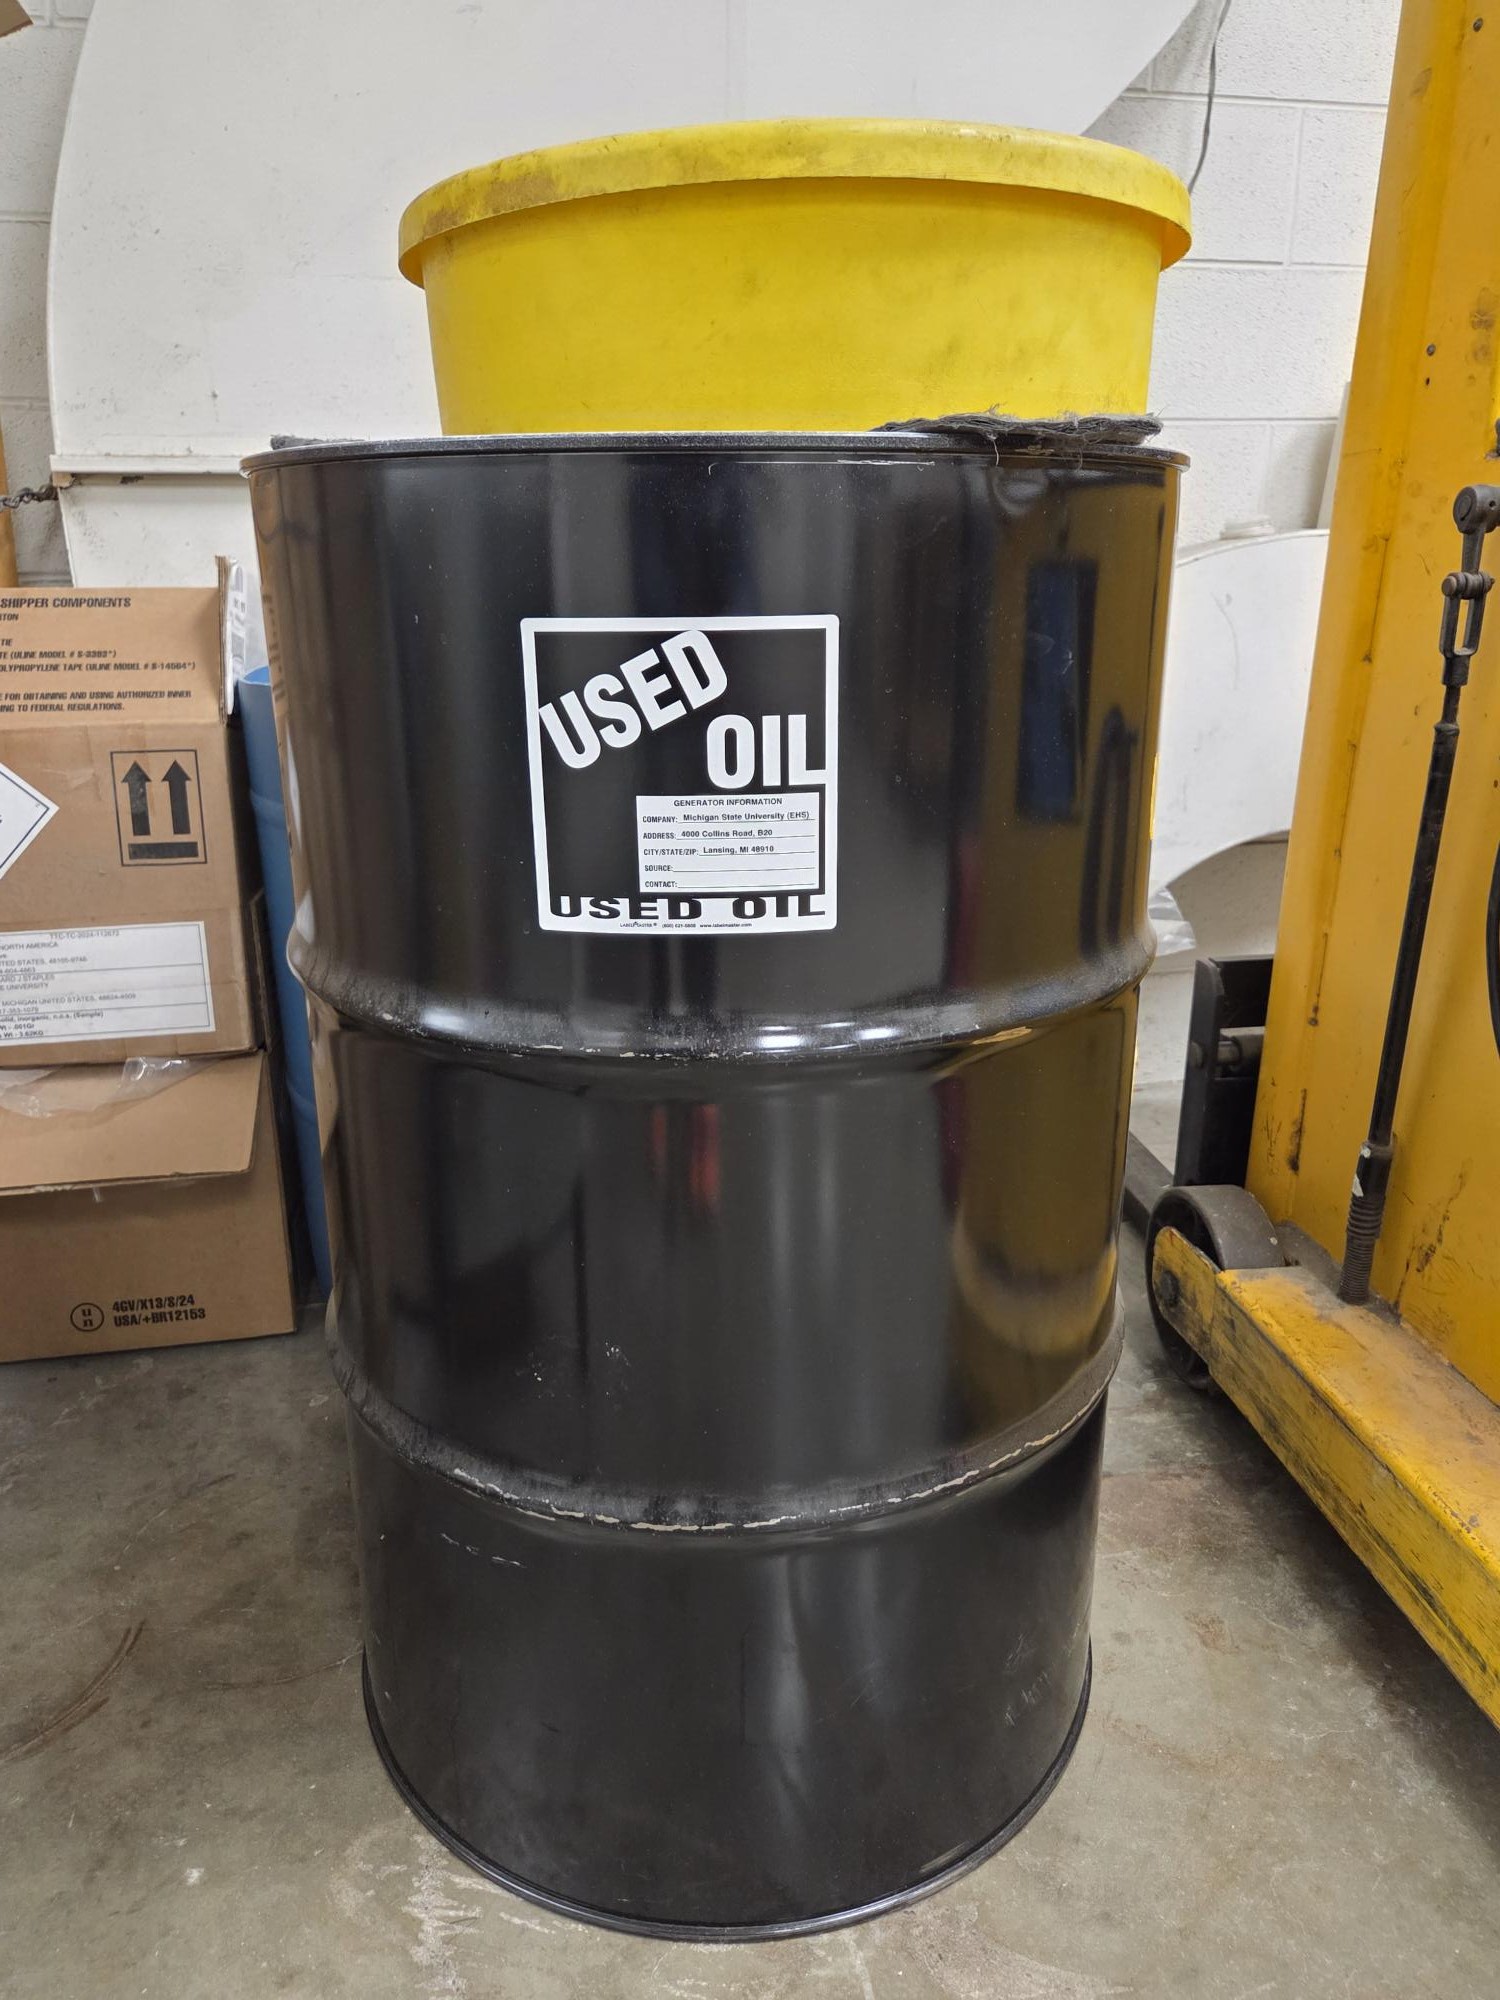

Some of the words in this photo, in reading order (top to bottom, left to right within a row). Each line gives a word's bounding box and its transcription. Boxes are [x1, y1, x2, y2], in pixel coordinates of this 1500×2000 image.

[0, 597, 49, 608] SHIPPER
[52, 597, 131, 608] COMPONENTS
[10, 651, 36, 659] (ULINE
[63, 663, 83, 671] TAPE
[85, 662, 110, 671] (ULINE
[113, 662, 140, 670] MODEL
[4, 692, 21, 701] FOR
[23, 691, 67, 700] OBTAINING
[69, 691, 87, 700] AND
[89, 690, 114, 699] USING
[116, 690, 165, 699] AUTHORIZED
[167, 689, 192, 698] INNER
[538, 629, 728, 769] USED
[0, 703, 15, 712] ING
[18, 703, 28, 712] TO
[30, 703, 64, 712] FEDERAL
[67, 702, 125, 711] REGULATIONS.
[706, 714, 826, 789] OIL
[674, 799, 725, 807] GENERATOR
[726, 798, 783, 806] INFORMATION
[683, 814, 720, 822] Michigan
[721, 813, 742, 821] State
[744, 812, 785, 821] University
[786, 811, 810, 820] (EHS)
[643, 832, 677, 840] ADDRESS:
[681, 830, 700, 838] 4000
[702, 830, 730, 838] Collins
[732, 830, 755, 838] Road,
[643, 848, 699, 856] CITY/STATE/ZIP:
[703, 846, 737, 854] Lansing,
[751, 845, 774, 853] 48910
[644, 864, 674, 872] SOURCE:
[645, 880, 678, 888] CONTACT:
[550, 896, 702, 920] USED
[732, 896, 826, 919] OIL
[26, 941, 58, 949] AMERICA
[6, 982, 49, 991] UNIVERSITY
[1, 999, 38, 1007] MICHIGAN
[39, 997, 66, 1005] UNITED
[113, 1308, 206, 1328] USA/+BR12153
